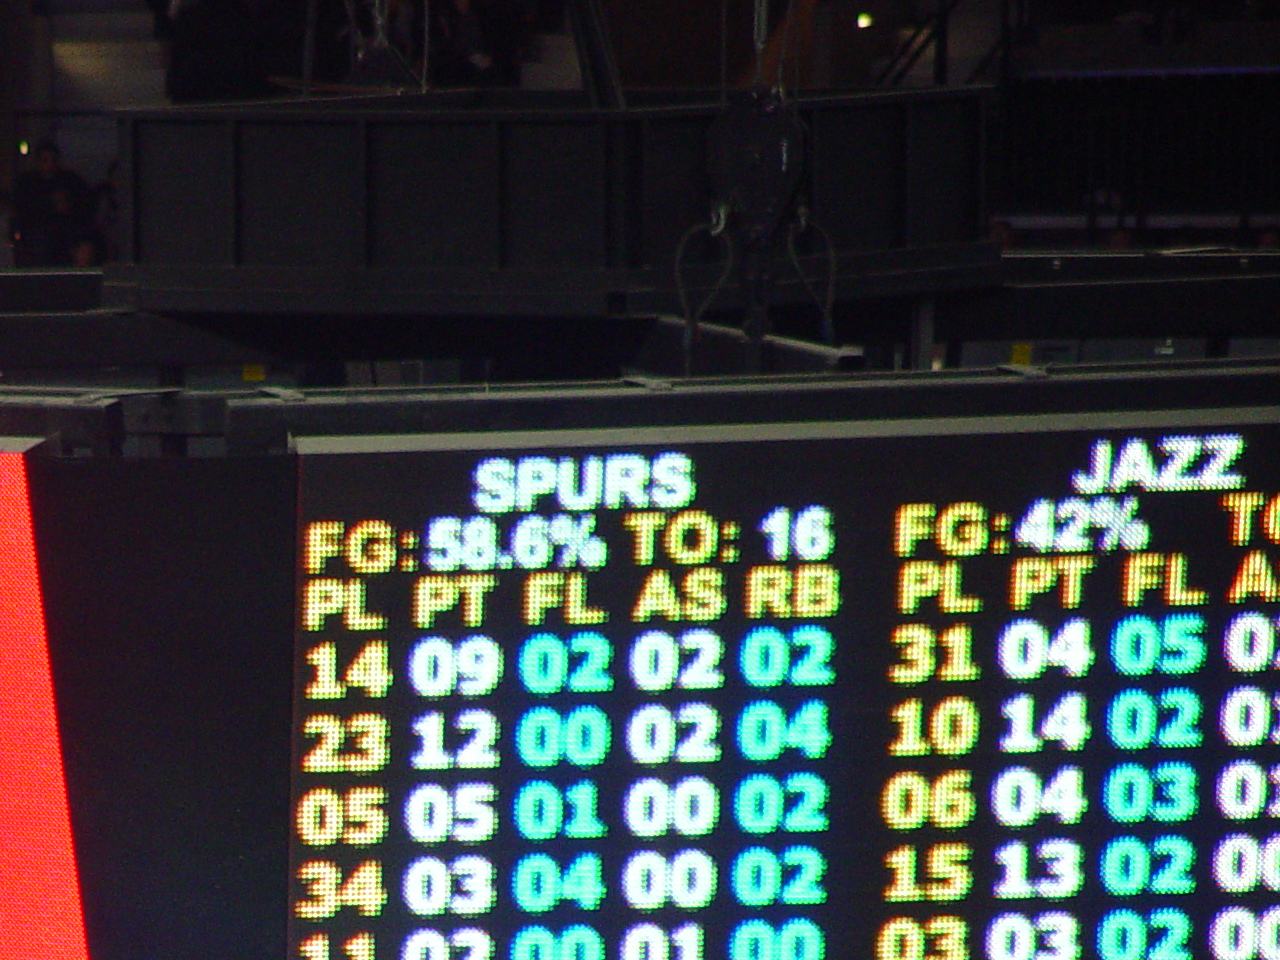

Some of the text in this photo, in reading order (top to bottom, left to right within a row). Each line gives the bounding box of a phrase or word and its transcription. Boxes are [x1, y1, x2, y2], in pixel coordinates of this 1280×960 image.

[473, 452, 697, 513] SPURS
[1071, 433, 1247, 494] JAZZ
[622, 509, 740, 565] TO:
[757, 504, 835, 561] 16
[302, 564, 842, 631] PL PT FL AS RB
[898, 560, 983, 614] PL
[1009, 555, 1096, 610] PT
[1123, 552, 1209, 607] FL
[304, 625, 836, 699] 14 09 02 02 02
[887, 623, 981, 683] 31
[995, 617, 1096, 680] 04
[1107, 613, 1207, 676] 05
[300, 698, 833, 772] 23 12 00 02 04
[888, 696, 980, 756] 10
[997, 691, 1092, 753] 14
[1104, 687, 1203, 749] 02
[294, 772, 830, 848] 05 05 01 00 02
[880, 769, 977, 829] 06
[988, 765, 1089, 827] 04
[1100, 760, 1199, 824] 03
[293, 845, 828, 918] 34 03 04 00 02
[882, 842, 974, 902] 15
[991, 837, 1085, 900] 13
[1097, 834, 1197, 896] 02
